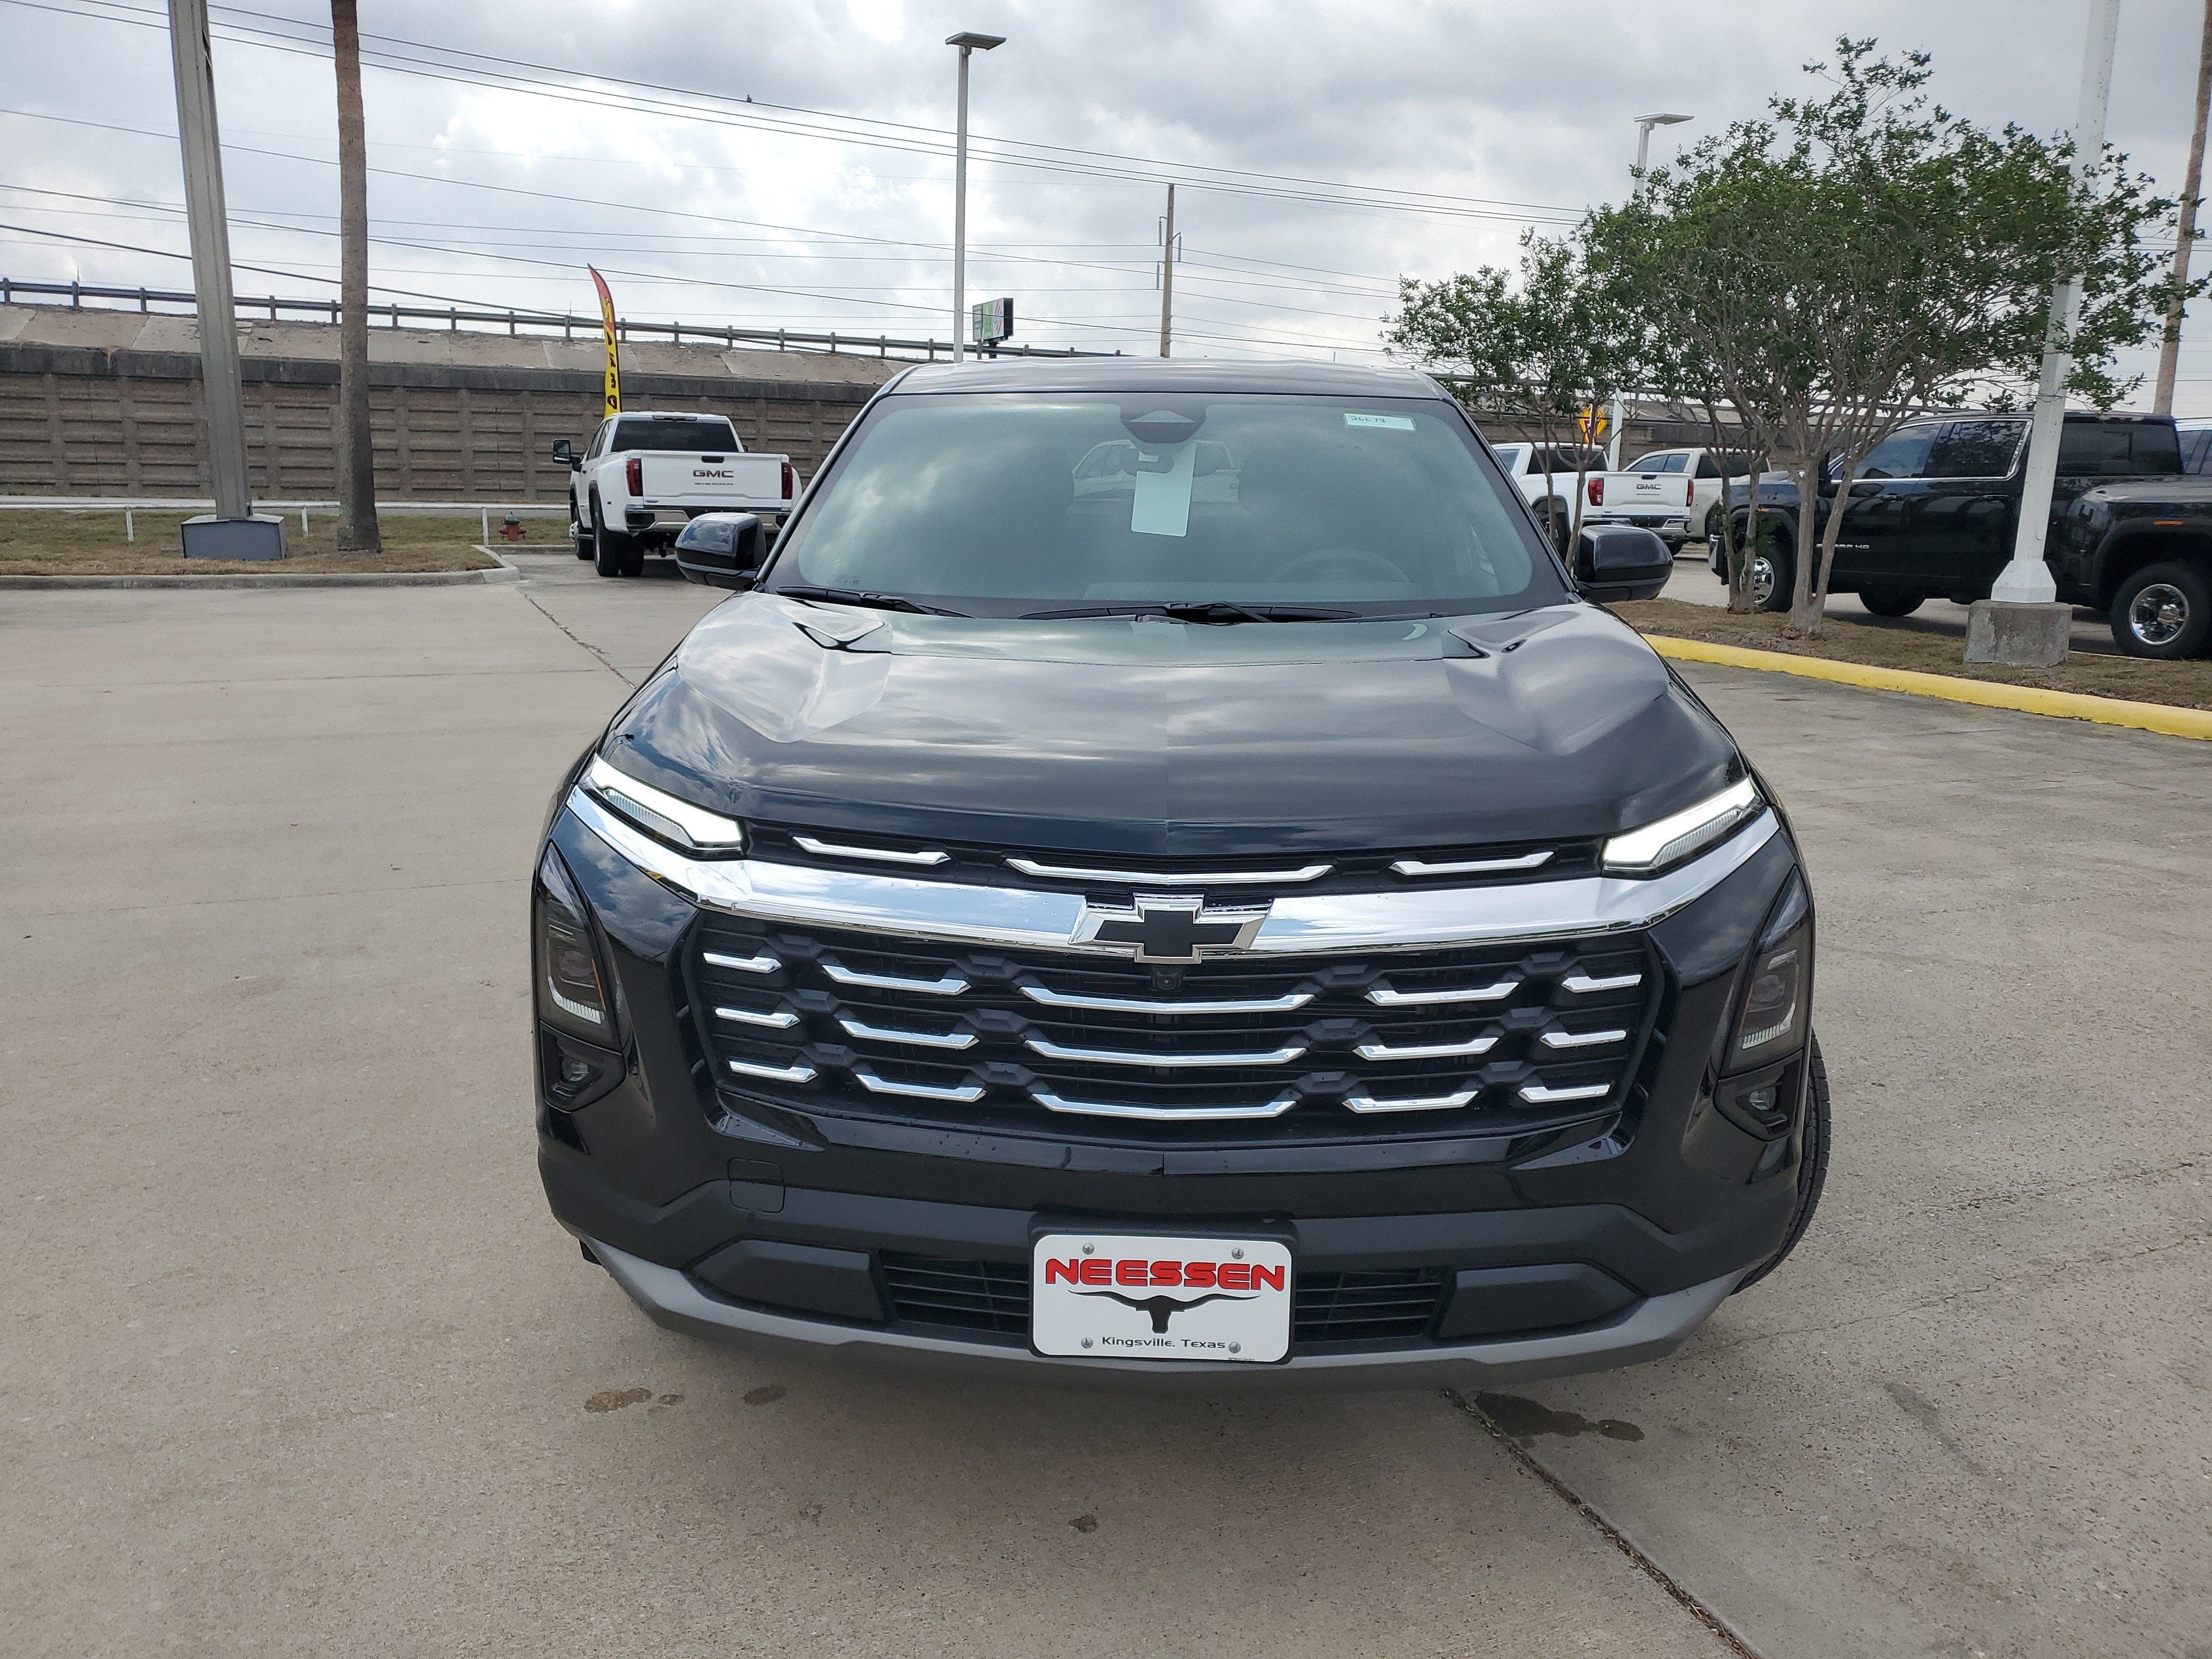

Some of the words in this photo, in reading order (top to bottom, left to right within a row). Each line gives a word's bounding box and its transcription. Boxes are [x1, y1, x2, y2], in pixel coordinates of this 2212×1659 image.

[693, 470, 735, 478] GMC
[1045, 1258, 1285, 1292] NEESSEN
[1102, 1336, 1176, 1348] Kingsville,
[1181, 1339, 1226, 1350] Texas
